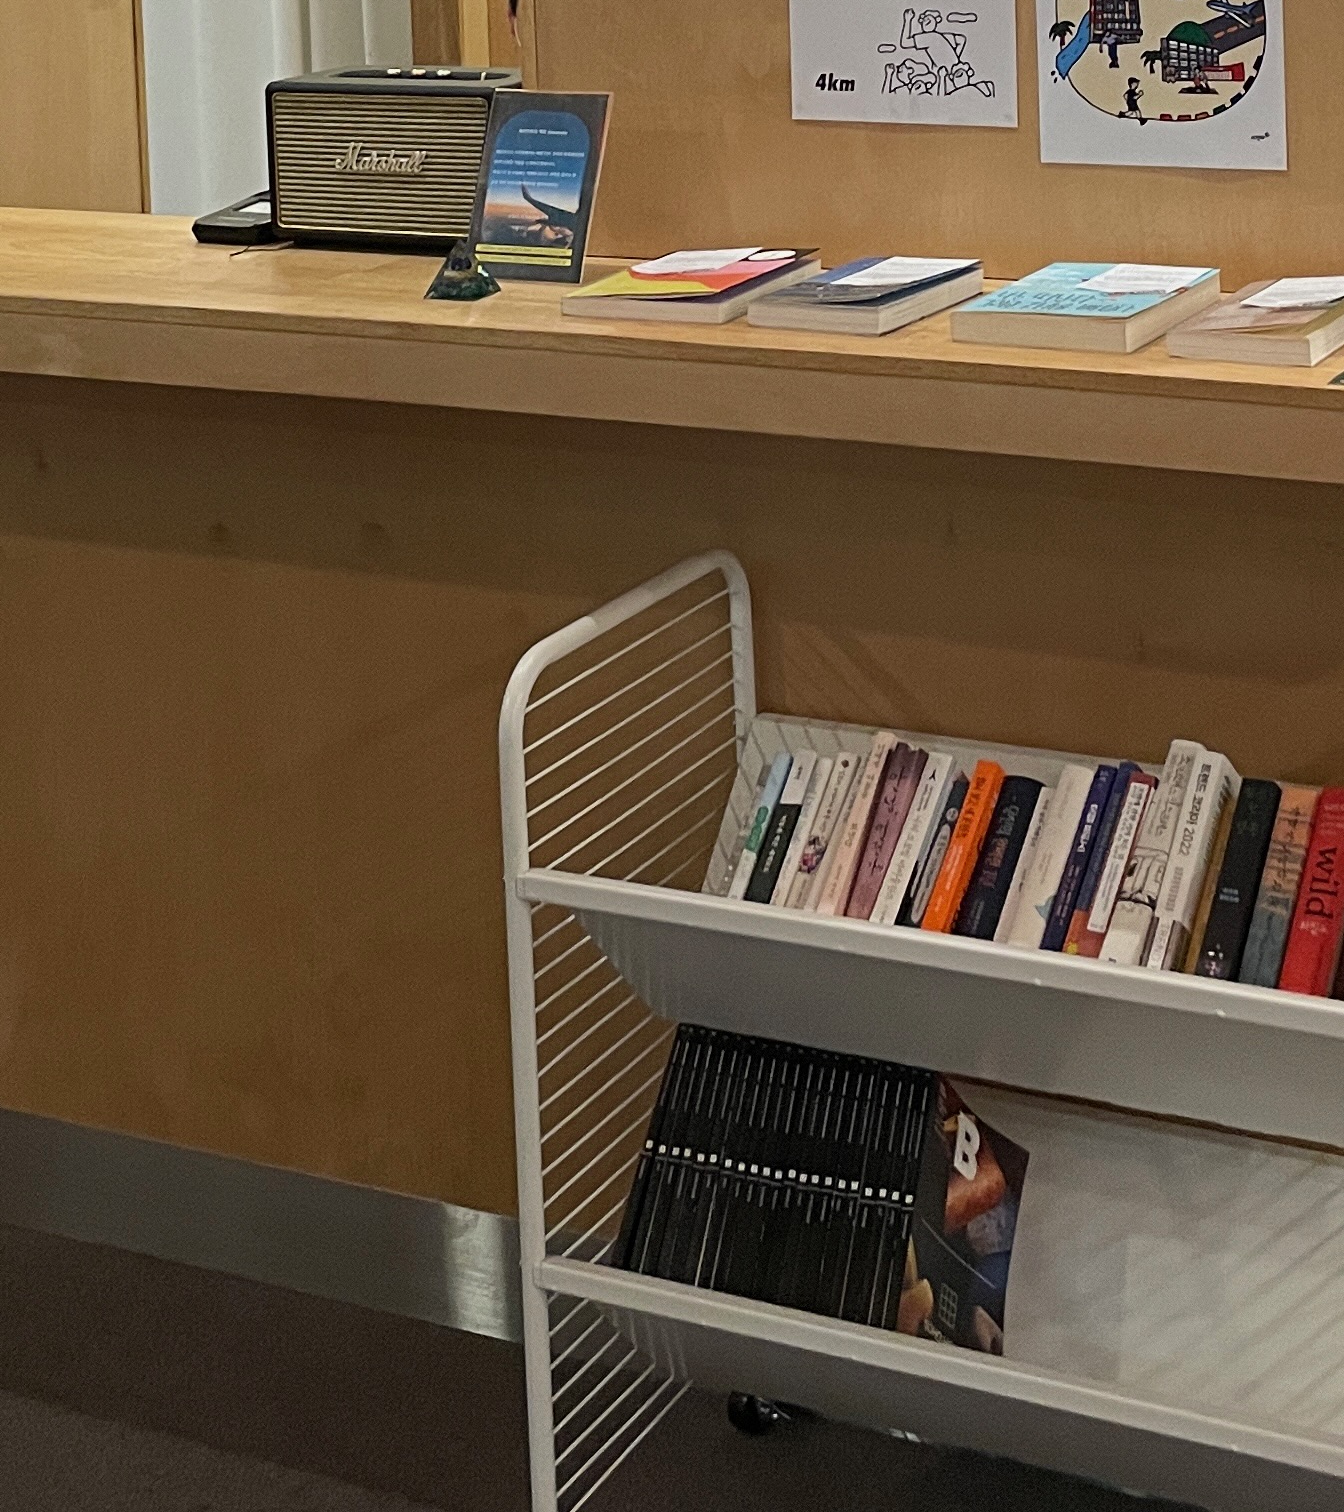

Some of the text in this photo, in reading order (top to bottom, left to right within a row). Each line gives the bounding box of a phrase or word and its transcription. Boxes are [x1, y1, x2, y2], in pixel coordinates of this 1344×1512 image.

[815, 73, 855, 92] 4km
[335, 141, 427, 174] Marshall
[1178, 763, 1212, 857] 트렌드 코리아 2022
[1304, 845, 1338, 920] wild
